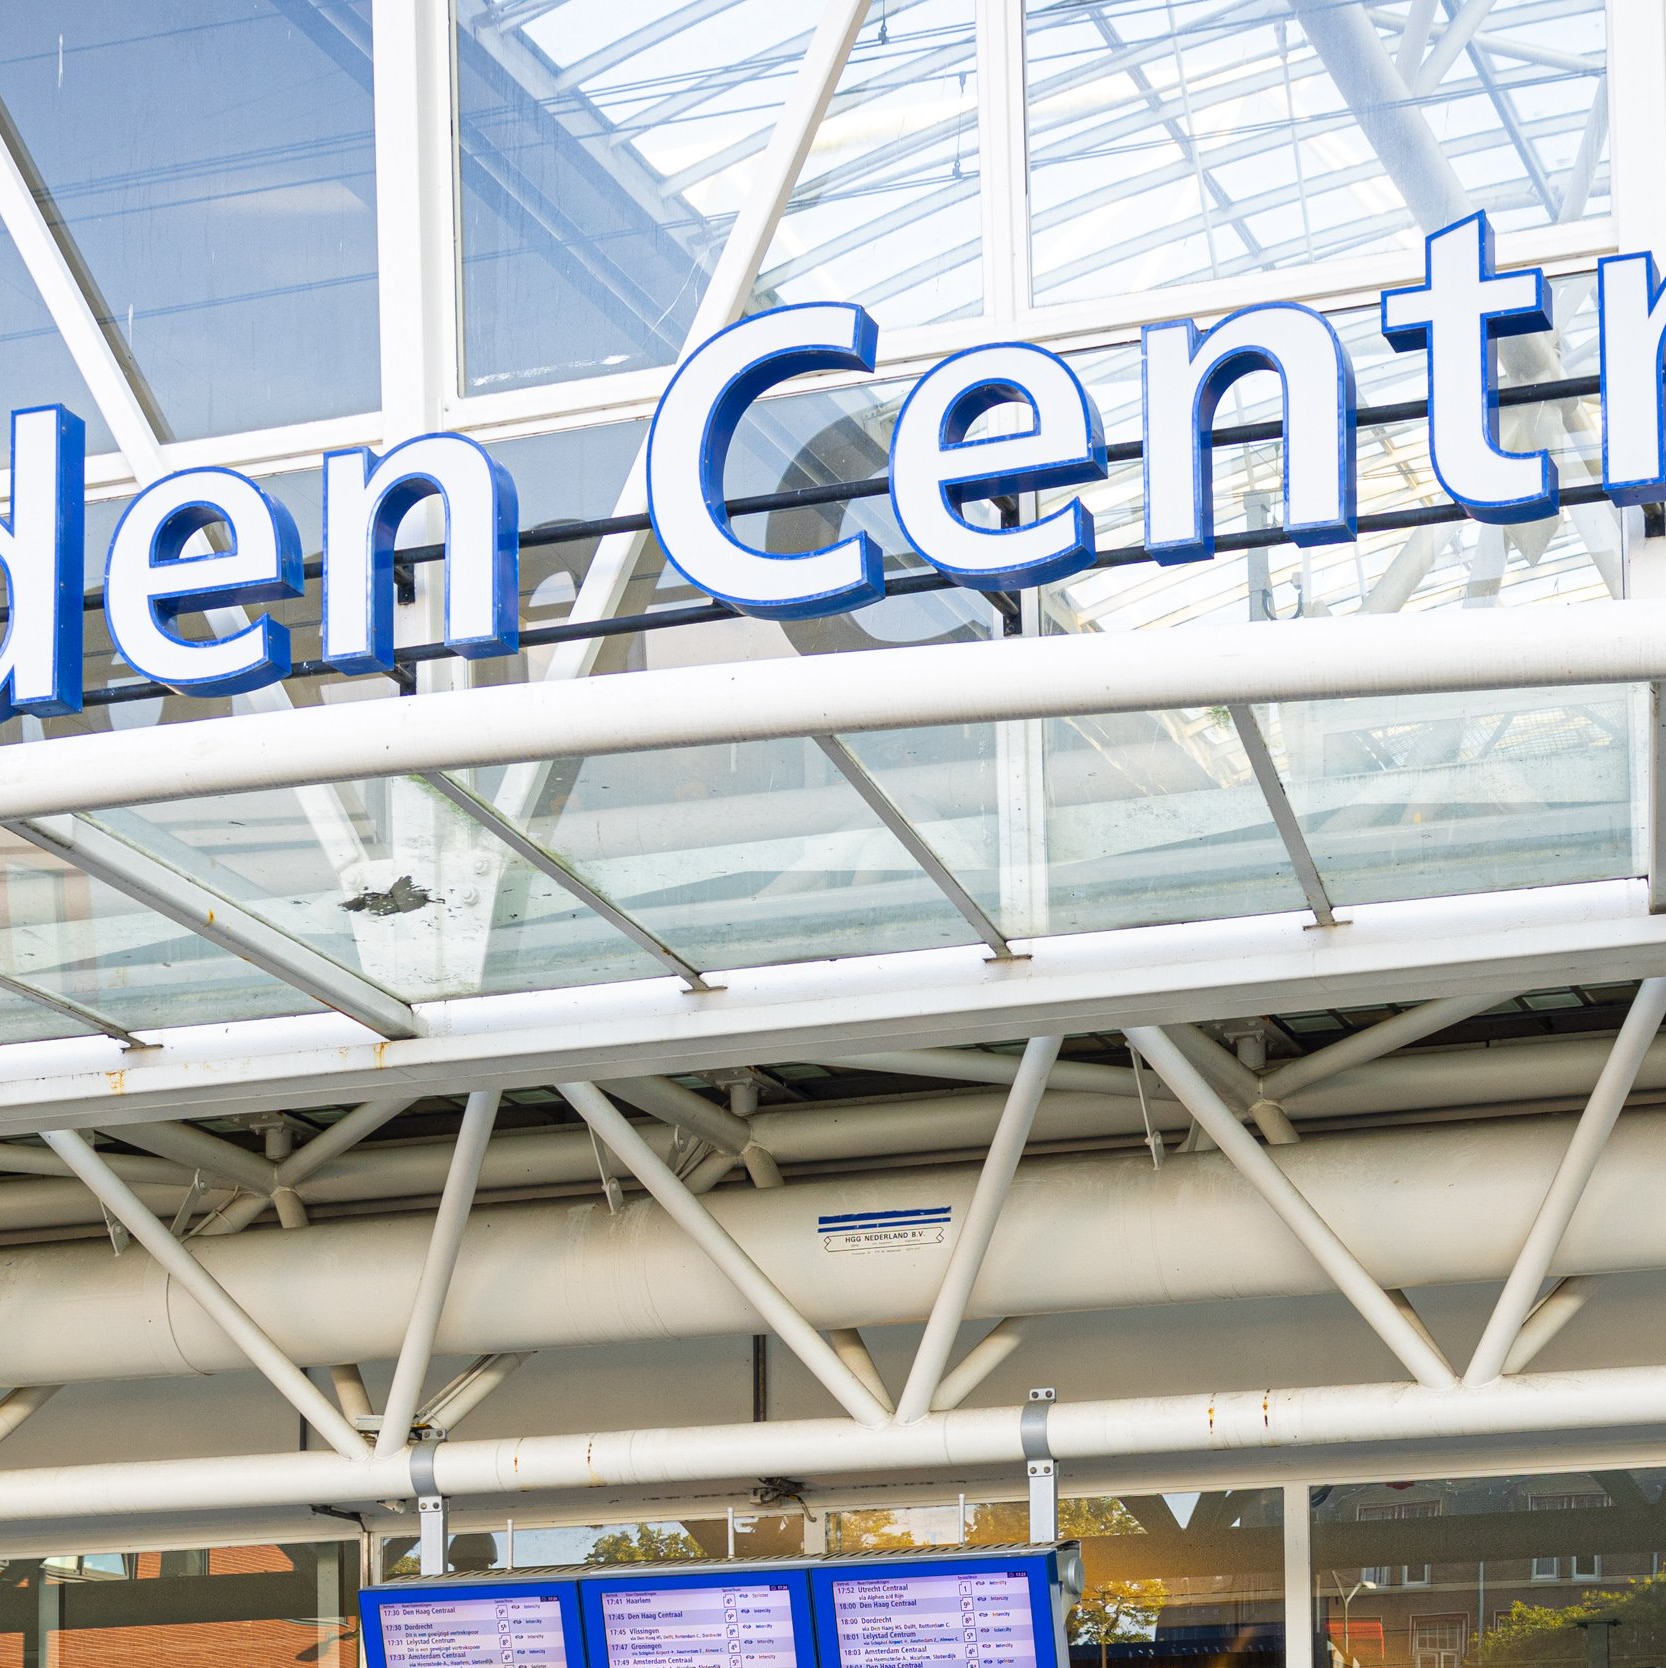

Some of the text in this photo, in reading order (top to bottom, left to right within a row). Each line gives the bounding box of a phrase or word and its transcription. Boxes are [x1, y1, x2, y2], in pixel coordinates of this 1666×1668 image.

[865, 1232, 908, 1242] NEDERLAND
[883, 1584, 908, 1592] Centraal
[626, 1597, 651, 1605] Haarlem
[873, 1601, 889, 1609] Haag
[891, 1599, 917, 1607] Centraal
[414, 1608, 429, 1616] Haag
[431, 1607, 455, 1615] Centraal
[641, 1612, 657, 1621] Haag
[863, 1632, 888, 1640] Lelystad
[407, 1638, 429, 1646] Lelystad
[631, 1643, 662, 1651] Groningen
